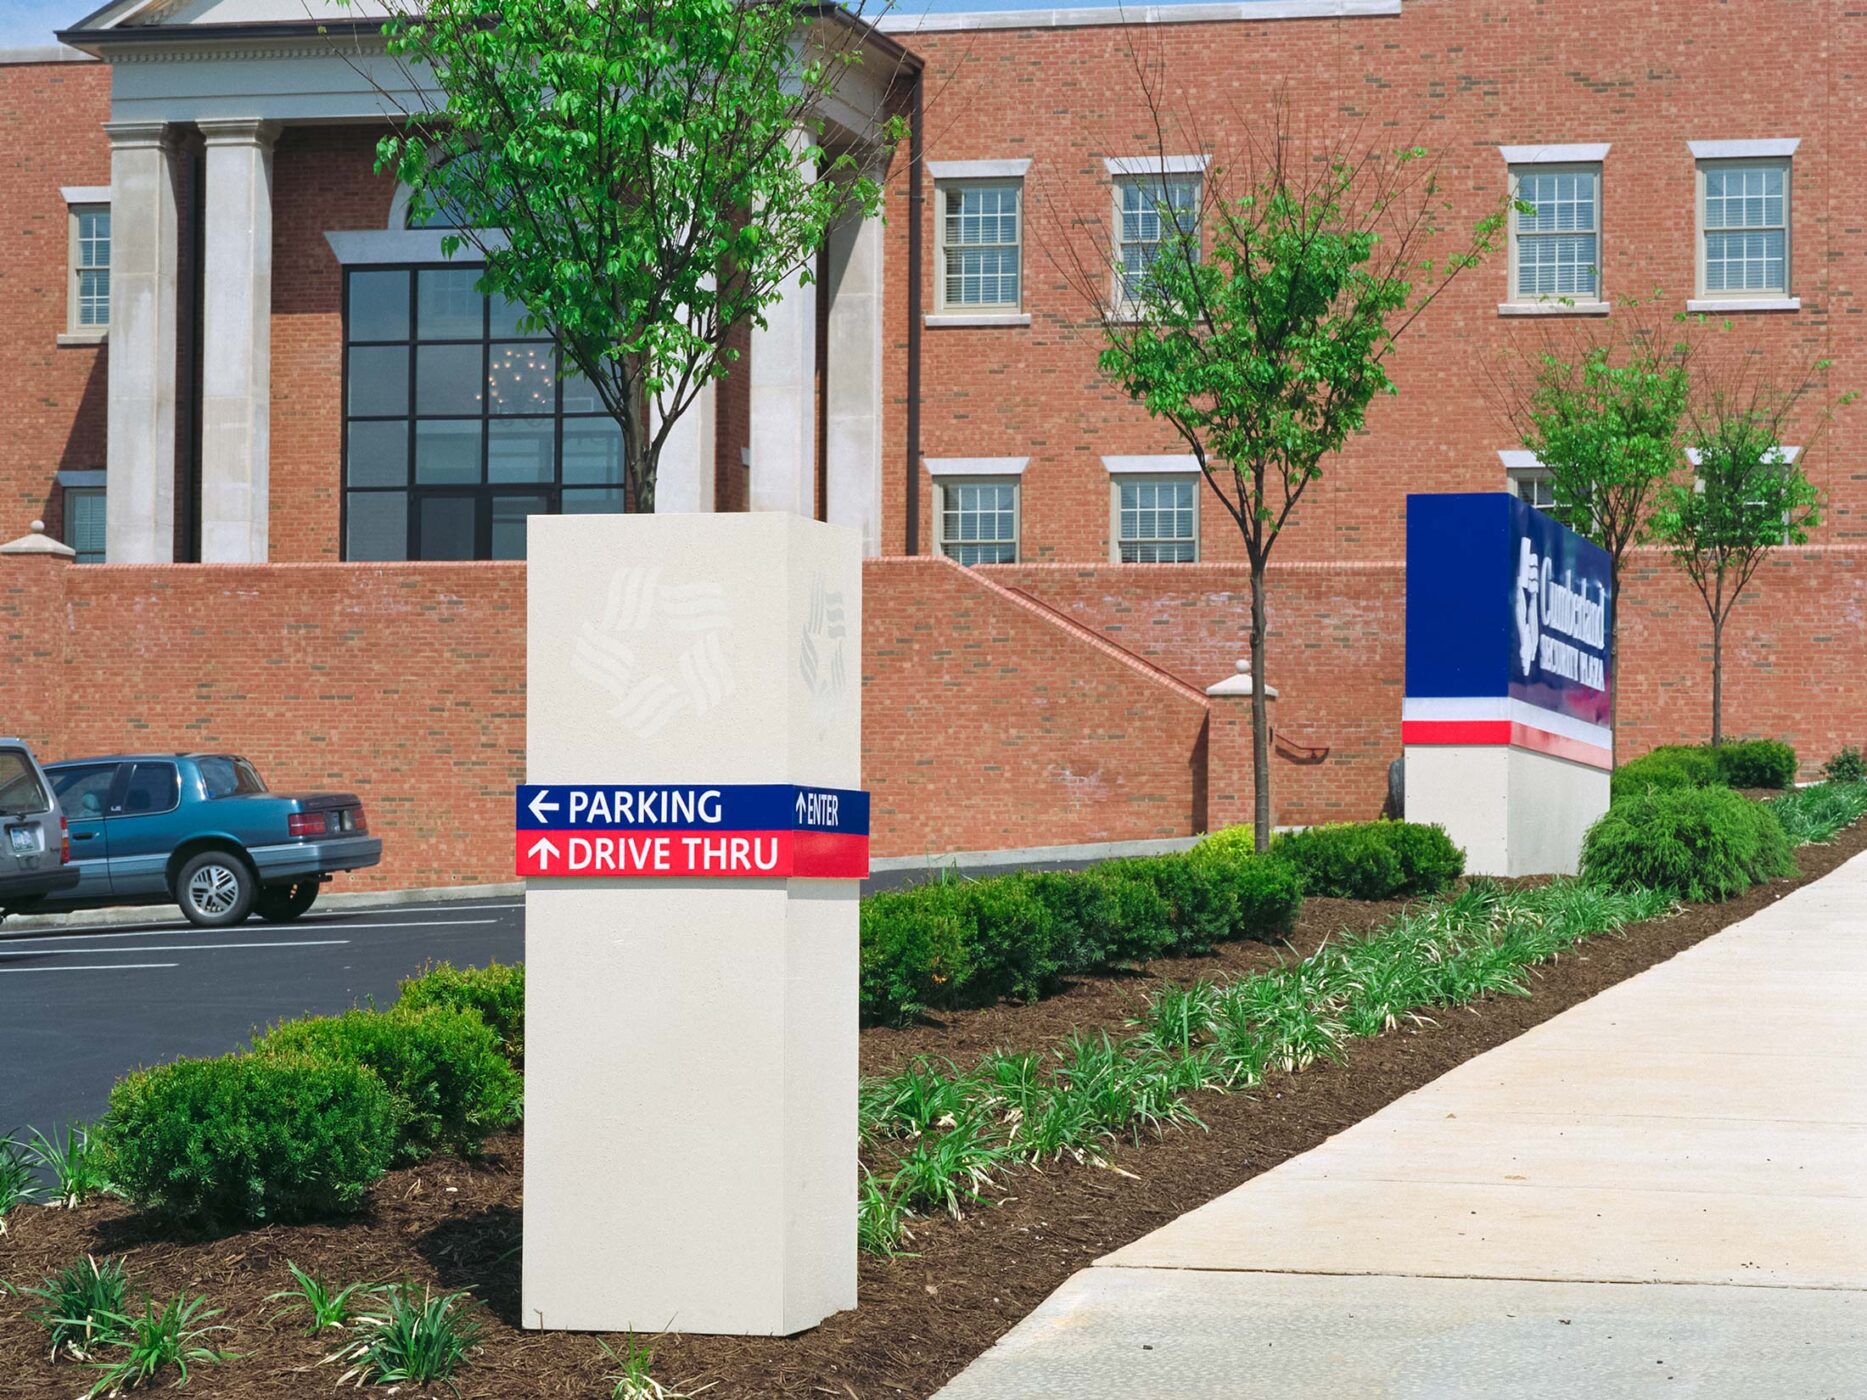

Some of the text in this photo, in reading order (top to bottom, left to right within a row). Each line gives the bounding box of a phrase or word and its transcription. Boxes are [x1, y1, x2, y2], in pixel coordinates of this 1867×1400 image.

[1540, 556, 1605, 650] Cumberland
[1539, 634, 1605, 692] SECURITY PLAZA
[569, 789, 722, 824] PARKING
[807, 792, 839, 827] ENTER
[568, 837, 779, 871] DRIVE THRU
